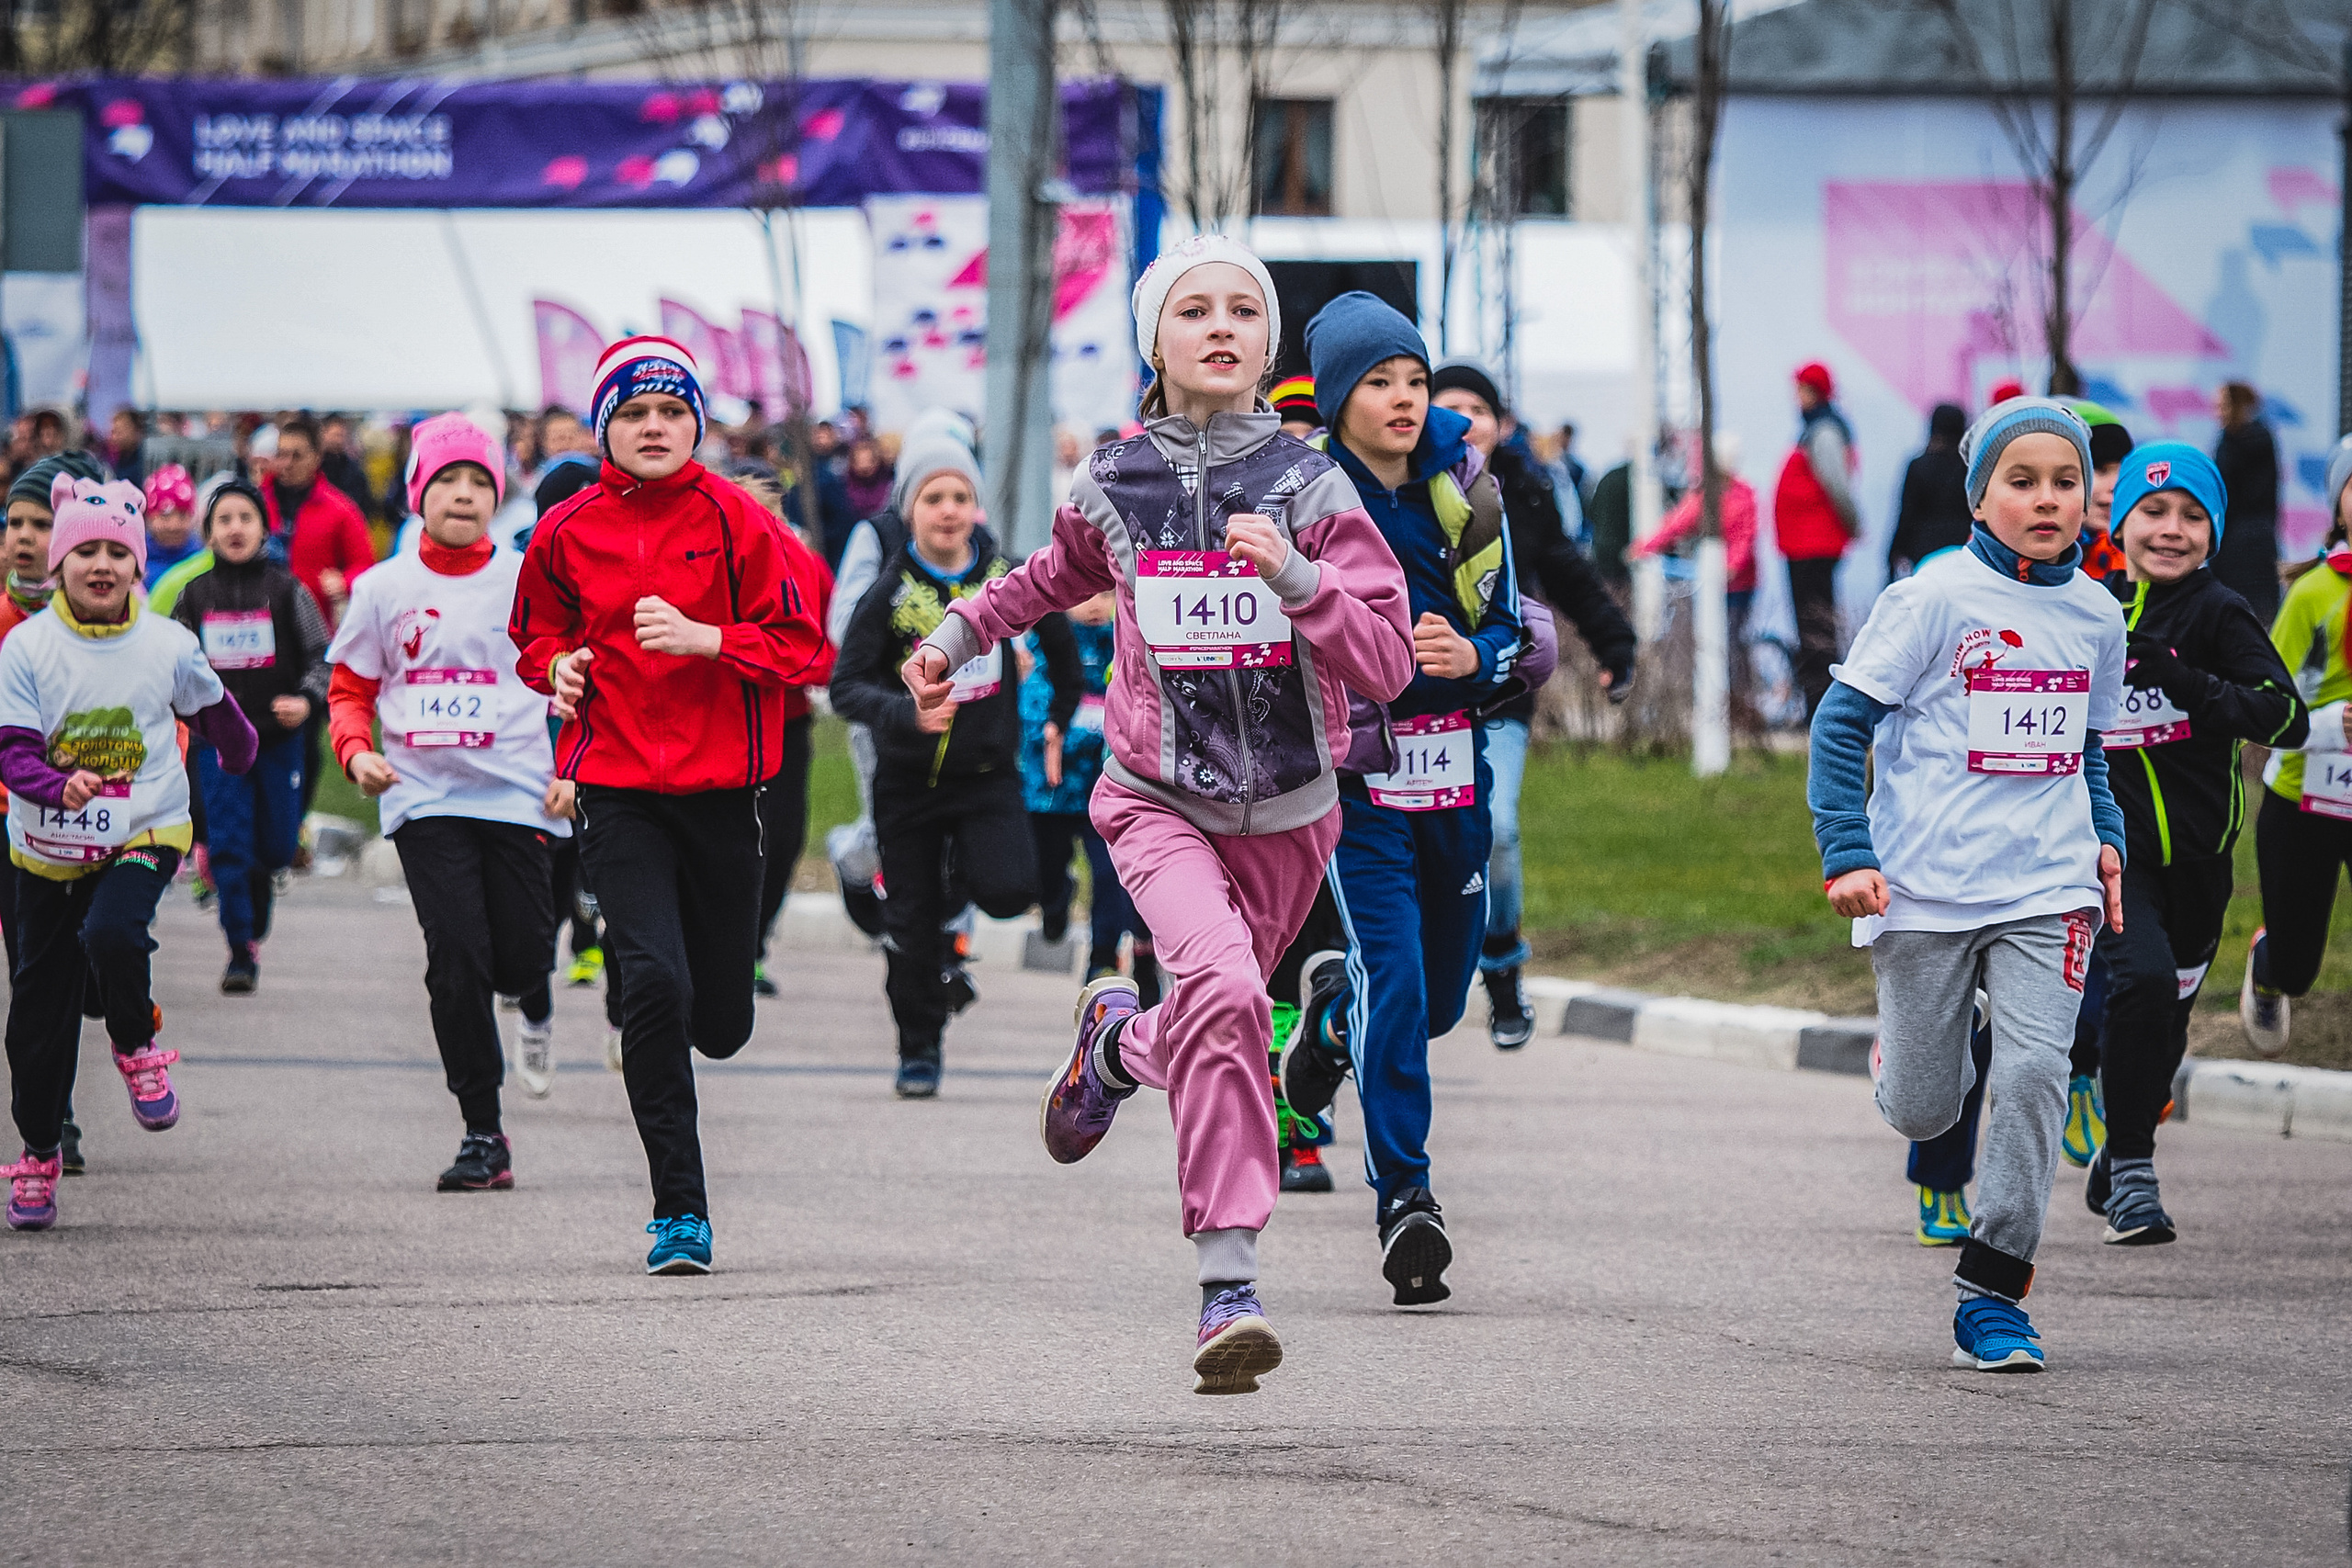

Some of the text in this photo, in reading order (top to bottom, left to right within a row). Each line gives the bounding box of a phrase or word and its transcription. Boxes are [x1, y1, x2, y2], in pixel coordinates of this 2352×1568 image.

[1172, 592, 1257, 626] 1410
[1185, 631, 1241, 640] СВЕТЛАНА
[1965, 629, 1991, 643] HOW
[420, 695, 481, 717] 1462
[2120, 685, 2162, 714] 68
[2003, 706, 2066, 735] 1412
[39, 805, 111, 832] 1448
